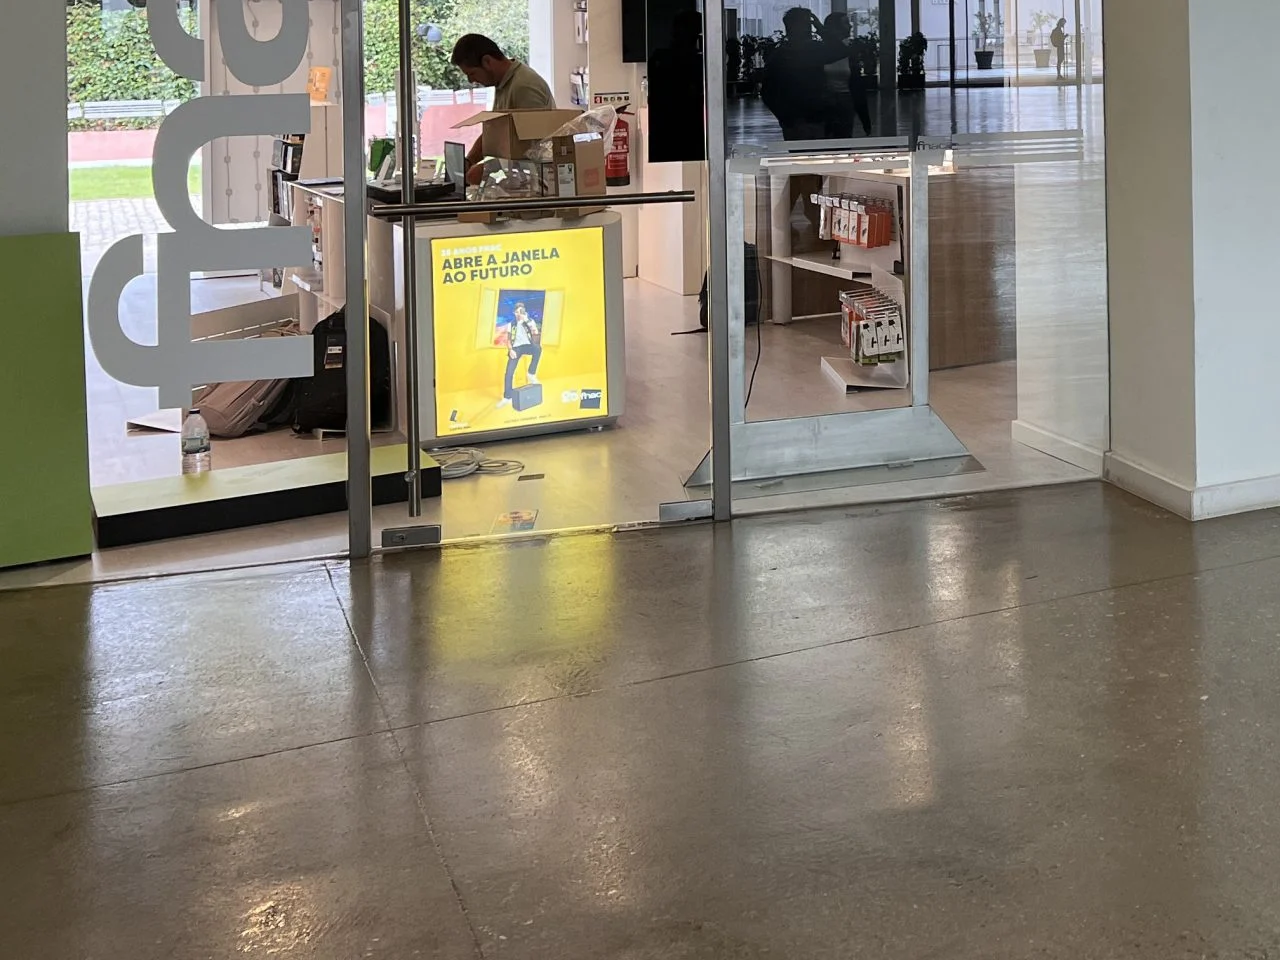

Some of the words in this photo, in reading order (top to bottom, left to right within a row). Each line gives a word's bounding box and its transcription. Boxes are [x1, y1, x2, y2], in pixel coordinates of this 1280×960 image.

[442, 256, 483, 270] ABRE
[486, 254, 498, 266] A
[501, 247, 560, 264] JANELA
[443, 271, 467, 284] AO
[470, 263, 533, 281] FUTURO
